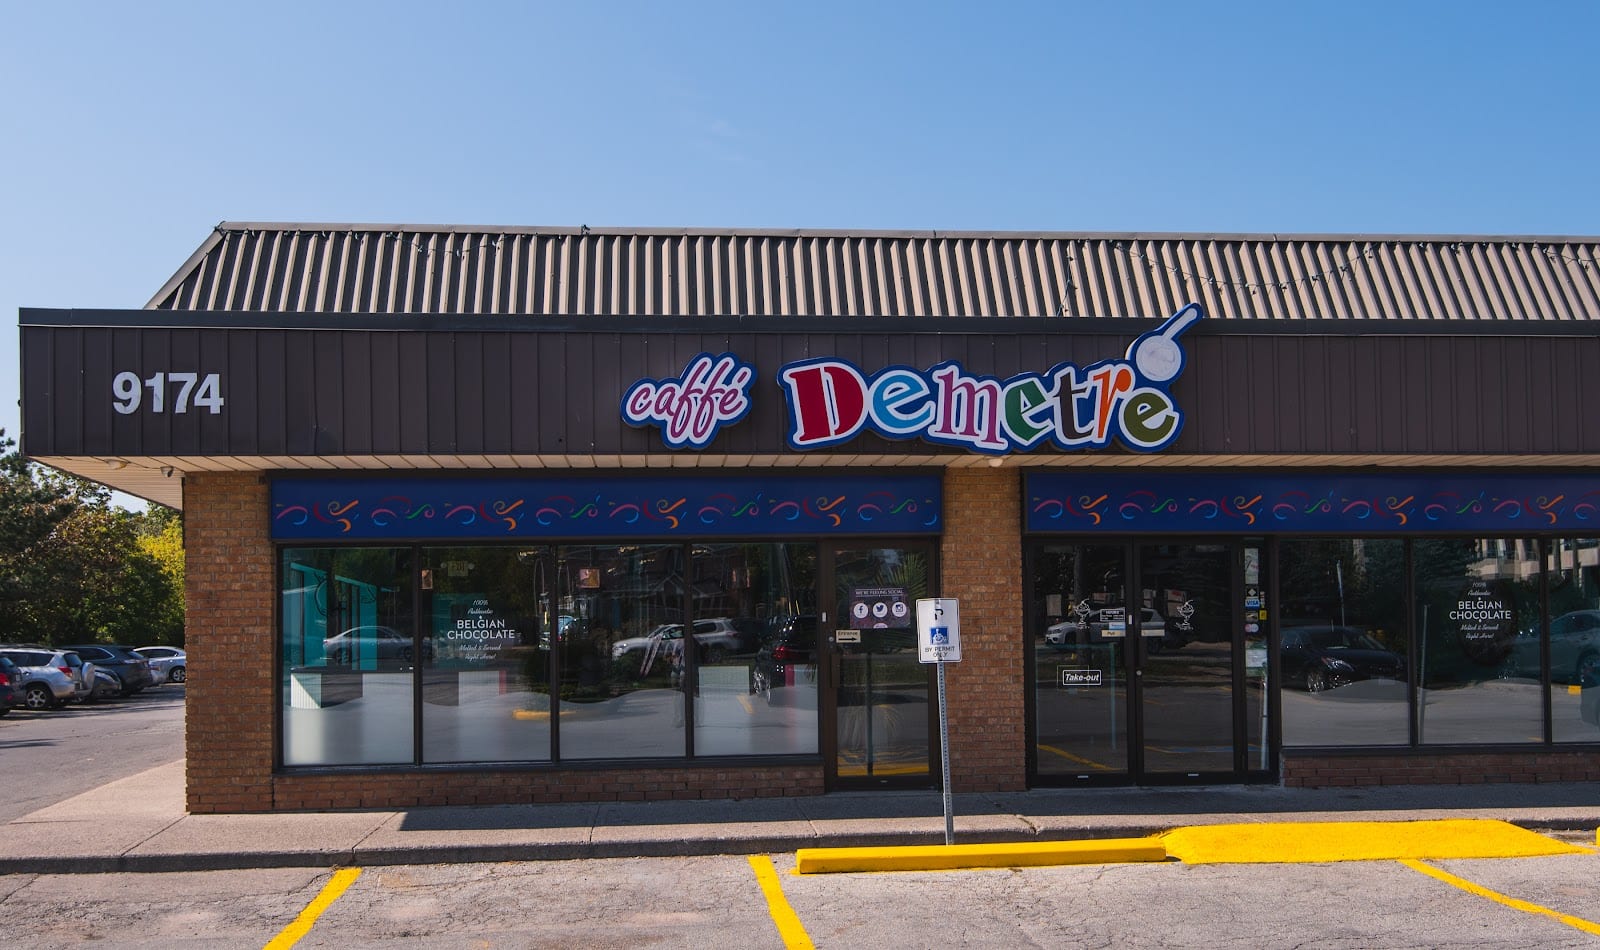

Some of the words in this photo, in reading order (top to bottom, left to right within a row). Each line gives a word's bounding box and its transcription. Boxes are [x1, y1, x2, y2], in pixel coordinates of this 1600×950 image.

[112, 371, 225, 414] 9174
[628, 356, 750, 442] caffé
[1458, 600, 1502, 610] BELGIAN
[1449, 610, 1512, 620] CHOCOLATE
[457, 619, 505, 629] BELGIAN
[447, 629, 516, 640] CHOCOLATE
[1064, 673, 1100, 682] Take-out
